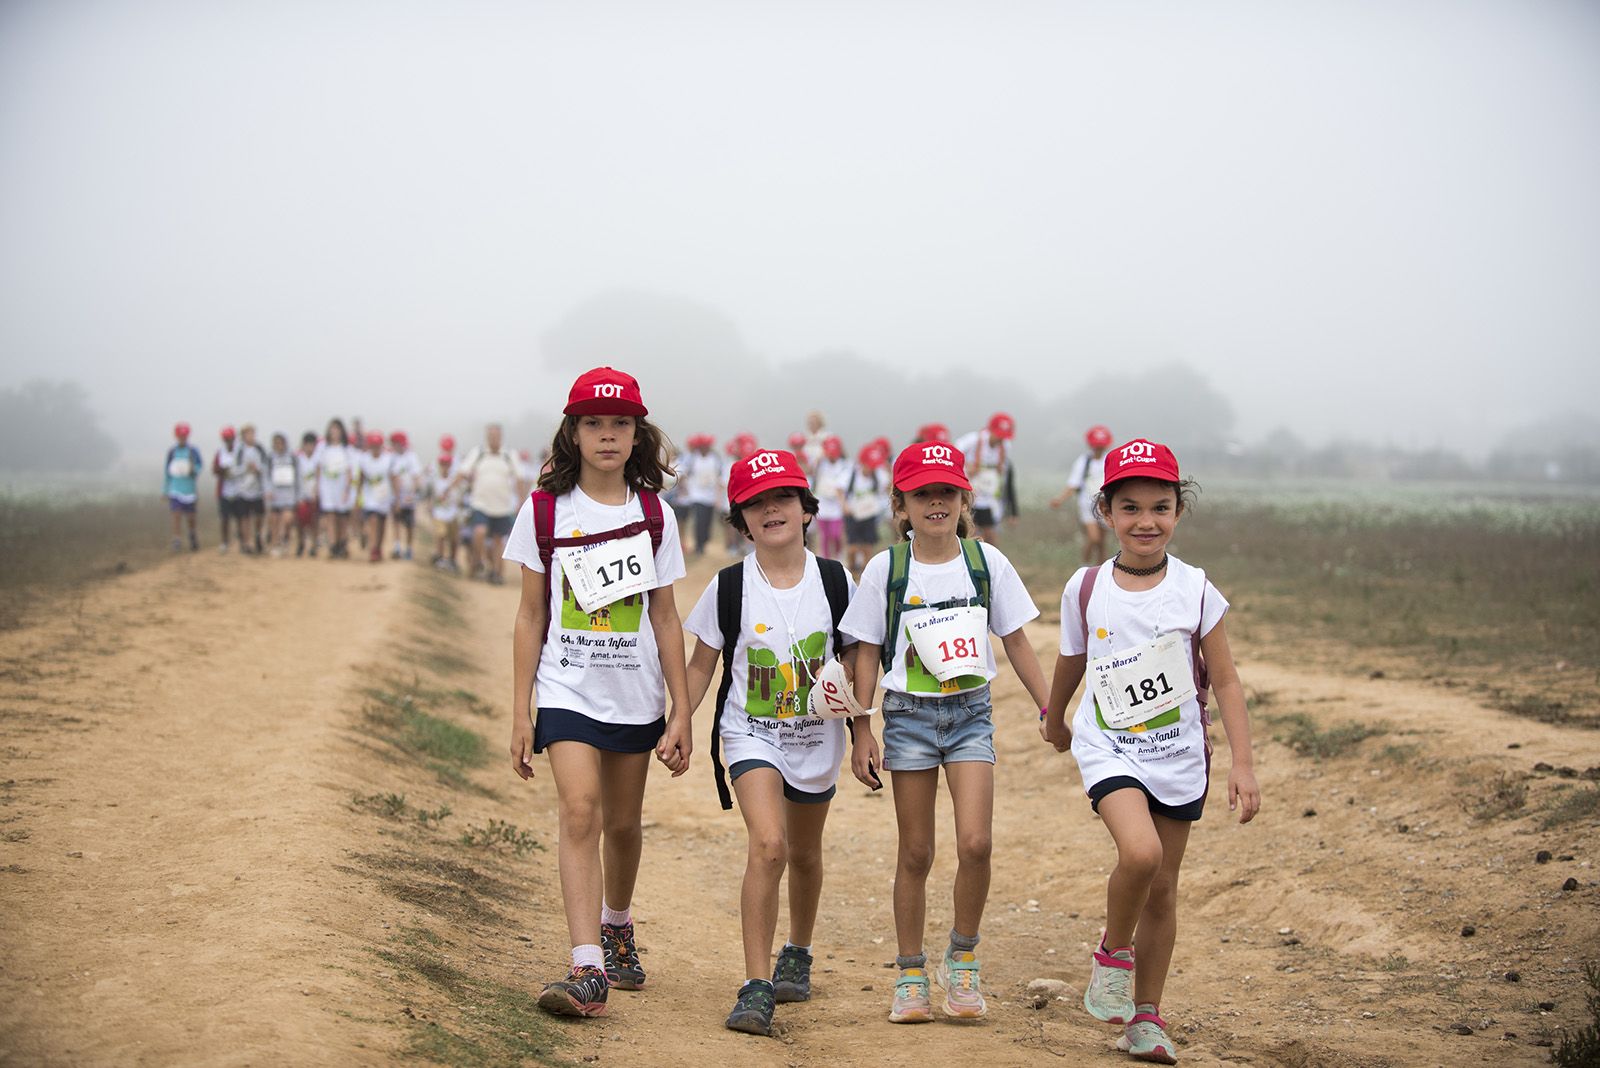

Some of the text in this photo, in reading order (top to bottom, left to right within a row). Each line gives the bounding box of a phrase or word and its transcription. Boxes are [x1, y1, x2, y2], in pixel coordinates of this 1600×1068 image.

[593, 383, 623, 398] TOT
[922, 445, 952, 460] TOT
[1120, 442, 1155, 459] TOT
[747, 452, 779, 472] TOT
[1119, 456, 1133, 467] Sant
[751, 468, 766, 479] Sant
[596, 554, 642, 588] 176
[576, 635, 606, 647] Marxa
[608, 637, 638, 650] Infantil
[938, 637, 979, 663] 181
[822, 680, 850, 714] 176
[1124, 671, 1173, 707] 181
